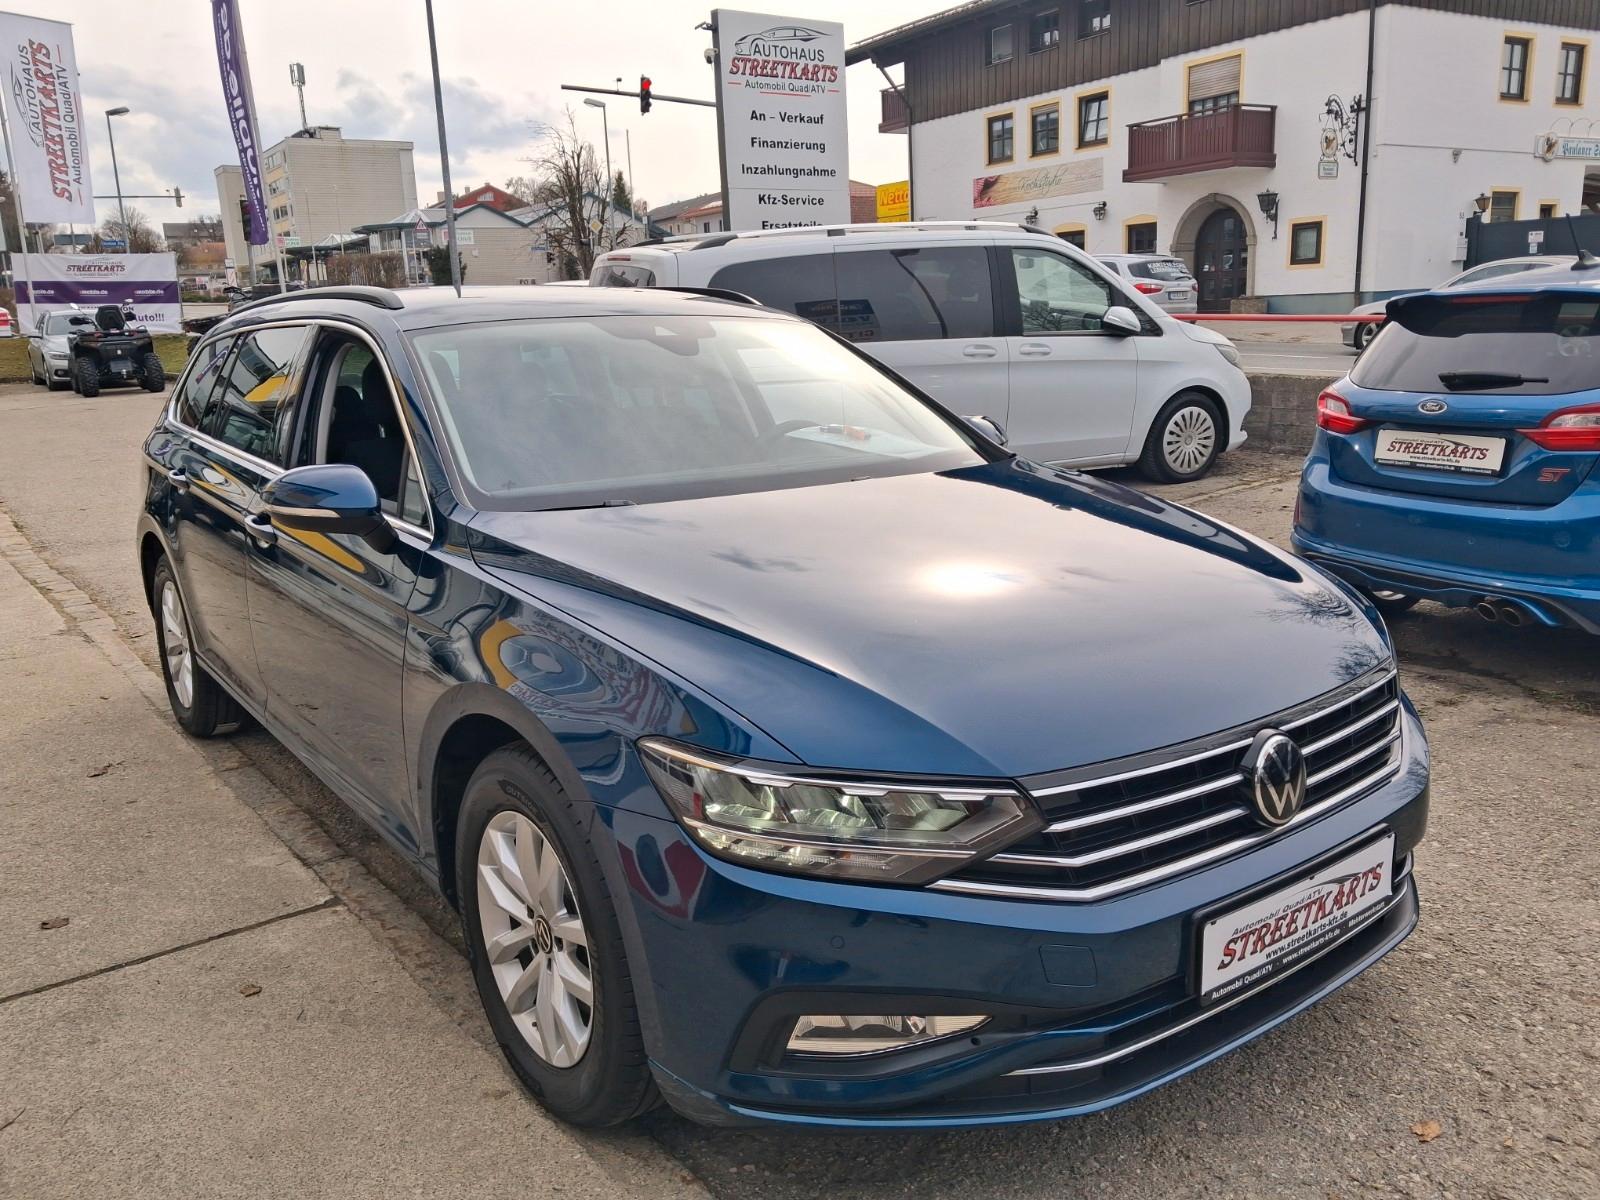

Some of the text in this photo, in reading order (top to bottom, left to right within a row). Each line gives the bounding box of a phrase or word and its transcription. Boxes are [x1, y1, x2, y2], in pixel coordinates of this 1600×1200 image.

[753, 43, 825, 62] AUTOHAUS
[729, 56, 839, 83] STREETKARTS
[18, 44, 42, 131] AUTOHAUS
[745, 80, 786, 91] Automobil
[28, 38, 73, 202] STREETKARTS
[55, 64, 82, 185] Automobil Quad/ATV
[750, 110, 766, 121] An
[779, 111, 824, 125] Verkauf
[750, 136, 826, 153] Finanzierung
[741, 163, 837, 178] Inzahlungnahme
[758, 193, 825, 206] Kfz-Service
[66, 264, 126, 273] STREETKARTS
[1387, 440, 1490, 461] STREETKARTS
[1536, 467, 1570, 482] ST
[1217, 861, 1384, 970] STREETKARTS
[1232, 909, 1280, 936] Automobil
[1265, 910, 1348, 960] www.streetkarts-kfz.de
[1212, 979, 1244, 1000] Automobil
